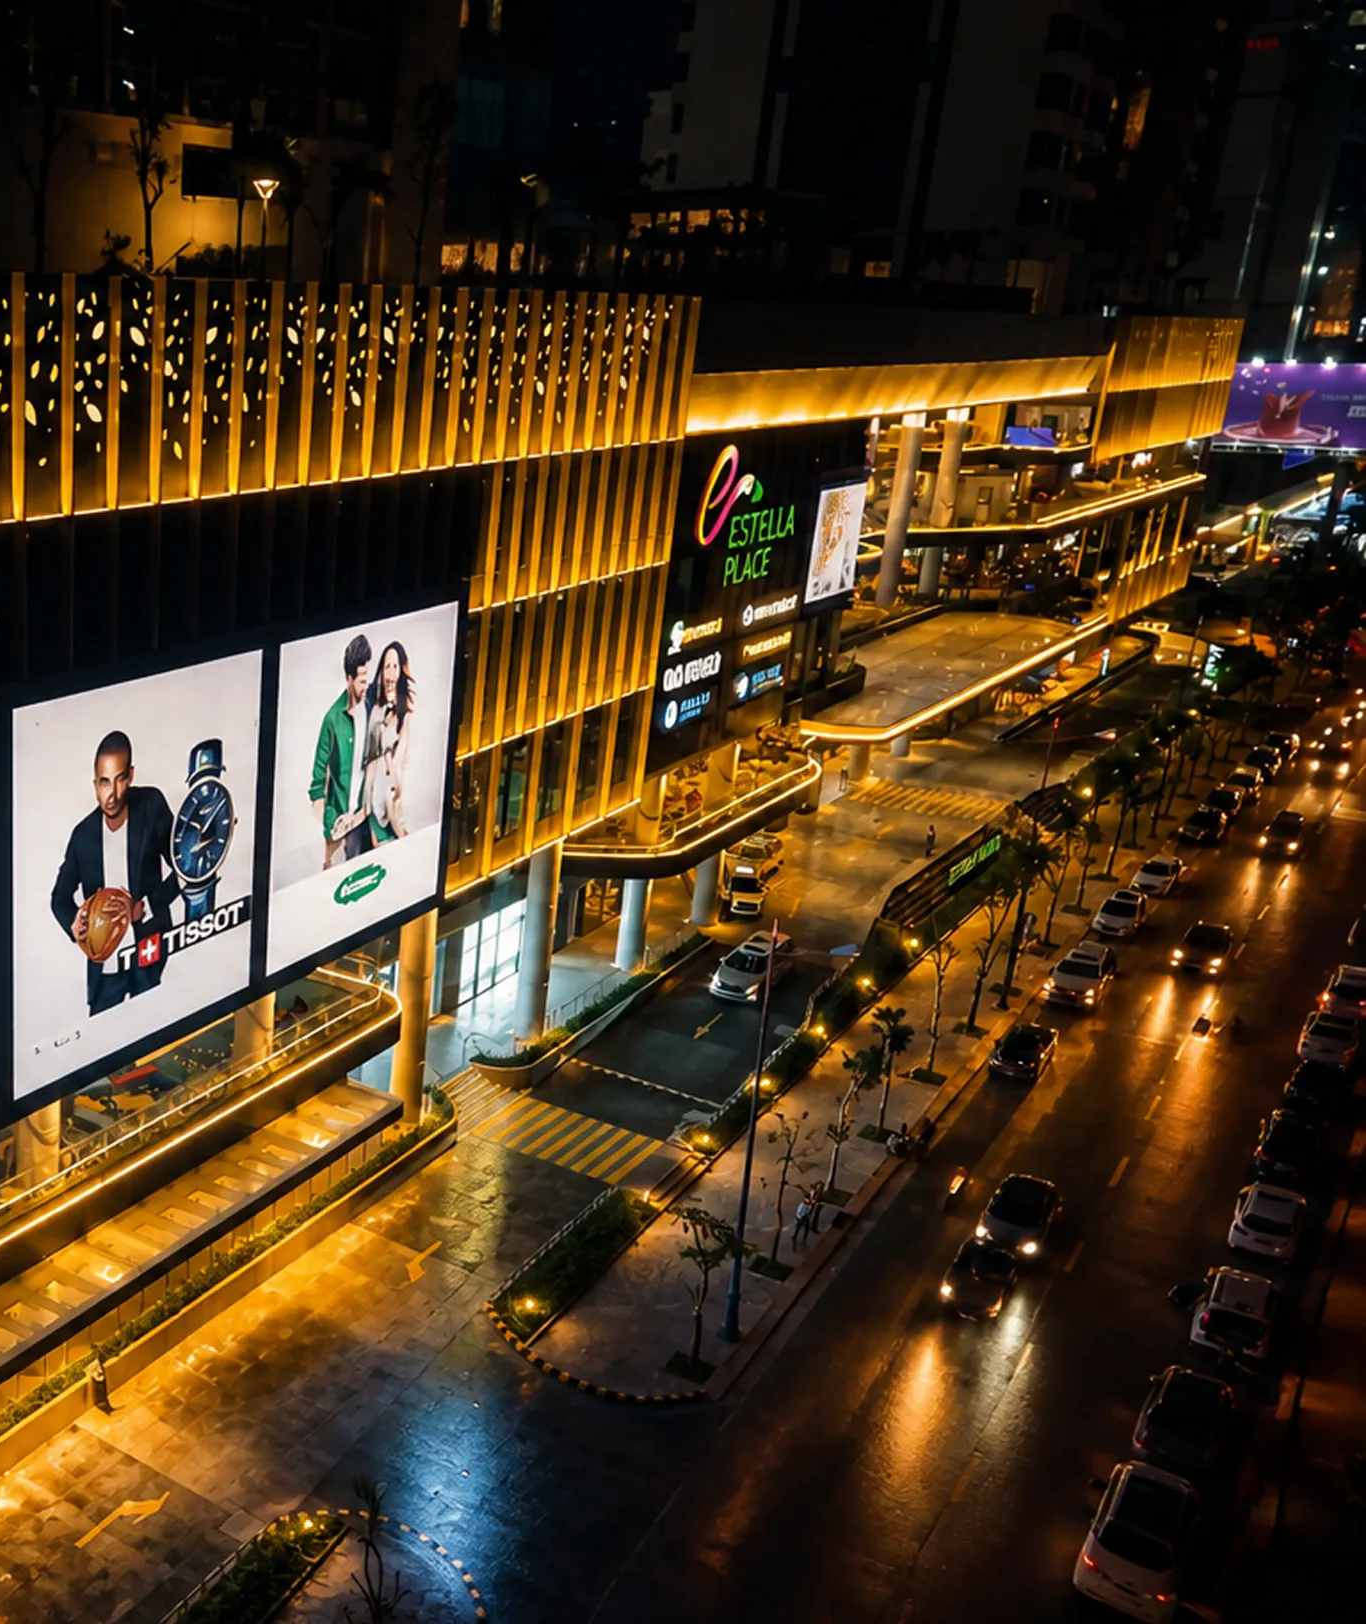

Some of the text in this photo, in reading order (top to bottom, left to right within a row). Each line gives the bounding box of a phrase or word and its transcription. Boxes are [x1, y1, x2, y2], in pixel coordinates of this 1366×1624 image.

[728, 504, 795, 549] ESTELLA
[722, 546, 772, 588] PLACE
[162, 901, 244, 953] TISSOT
